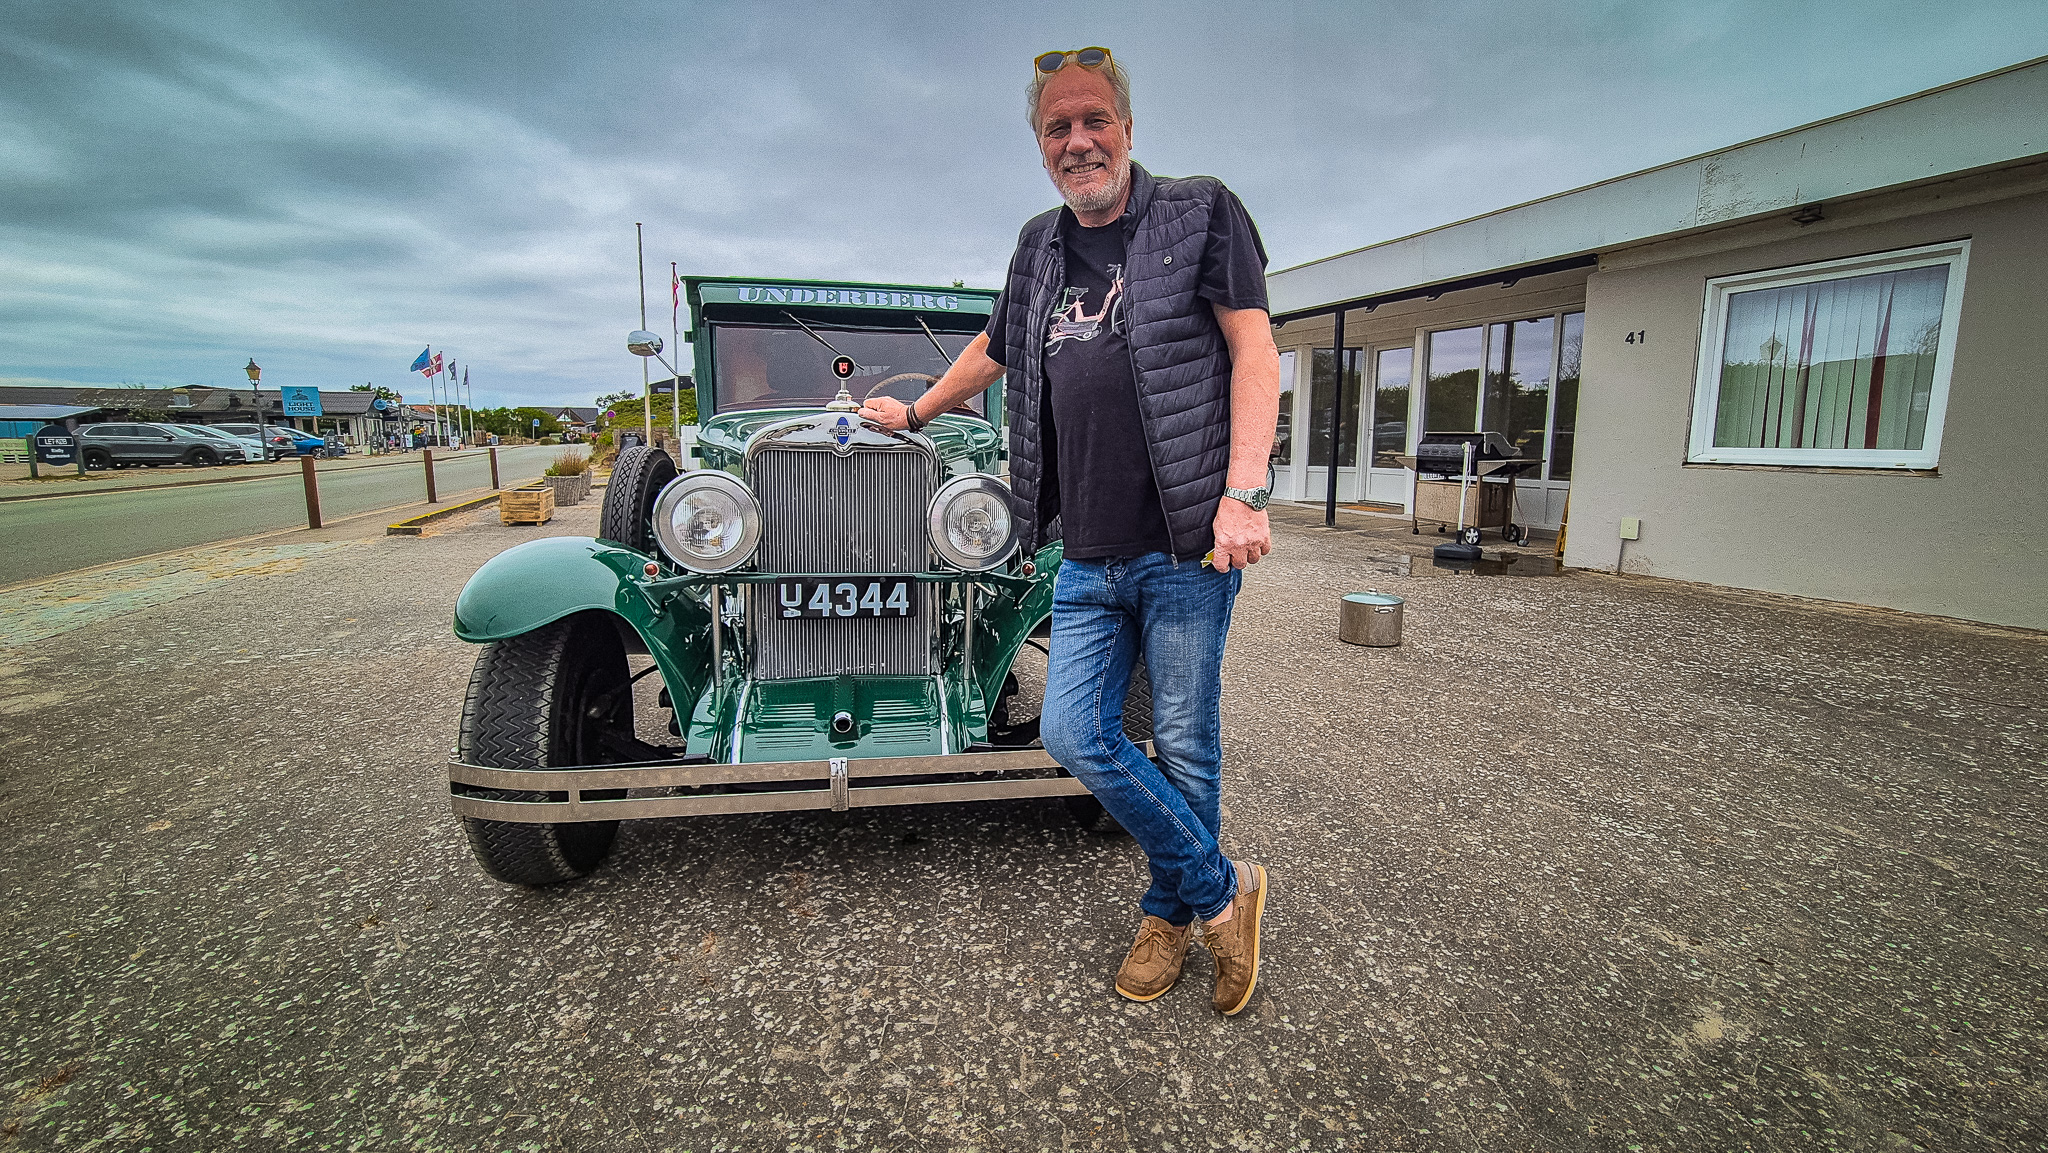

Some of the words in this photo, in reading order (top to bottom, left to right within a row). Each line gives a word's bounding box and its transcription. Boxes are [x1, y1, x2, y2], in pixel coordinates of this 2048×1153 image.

[738, 287, 959, 310] UNDERBERG
[1625, 330, 1646, 345] 41
[780, 583, 802, 607] U
[808, 582, 910, 617] 4344
